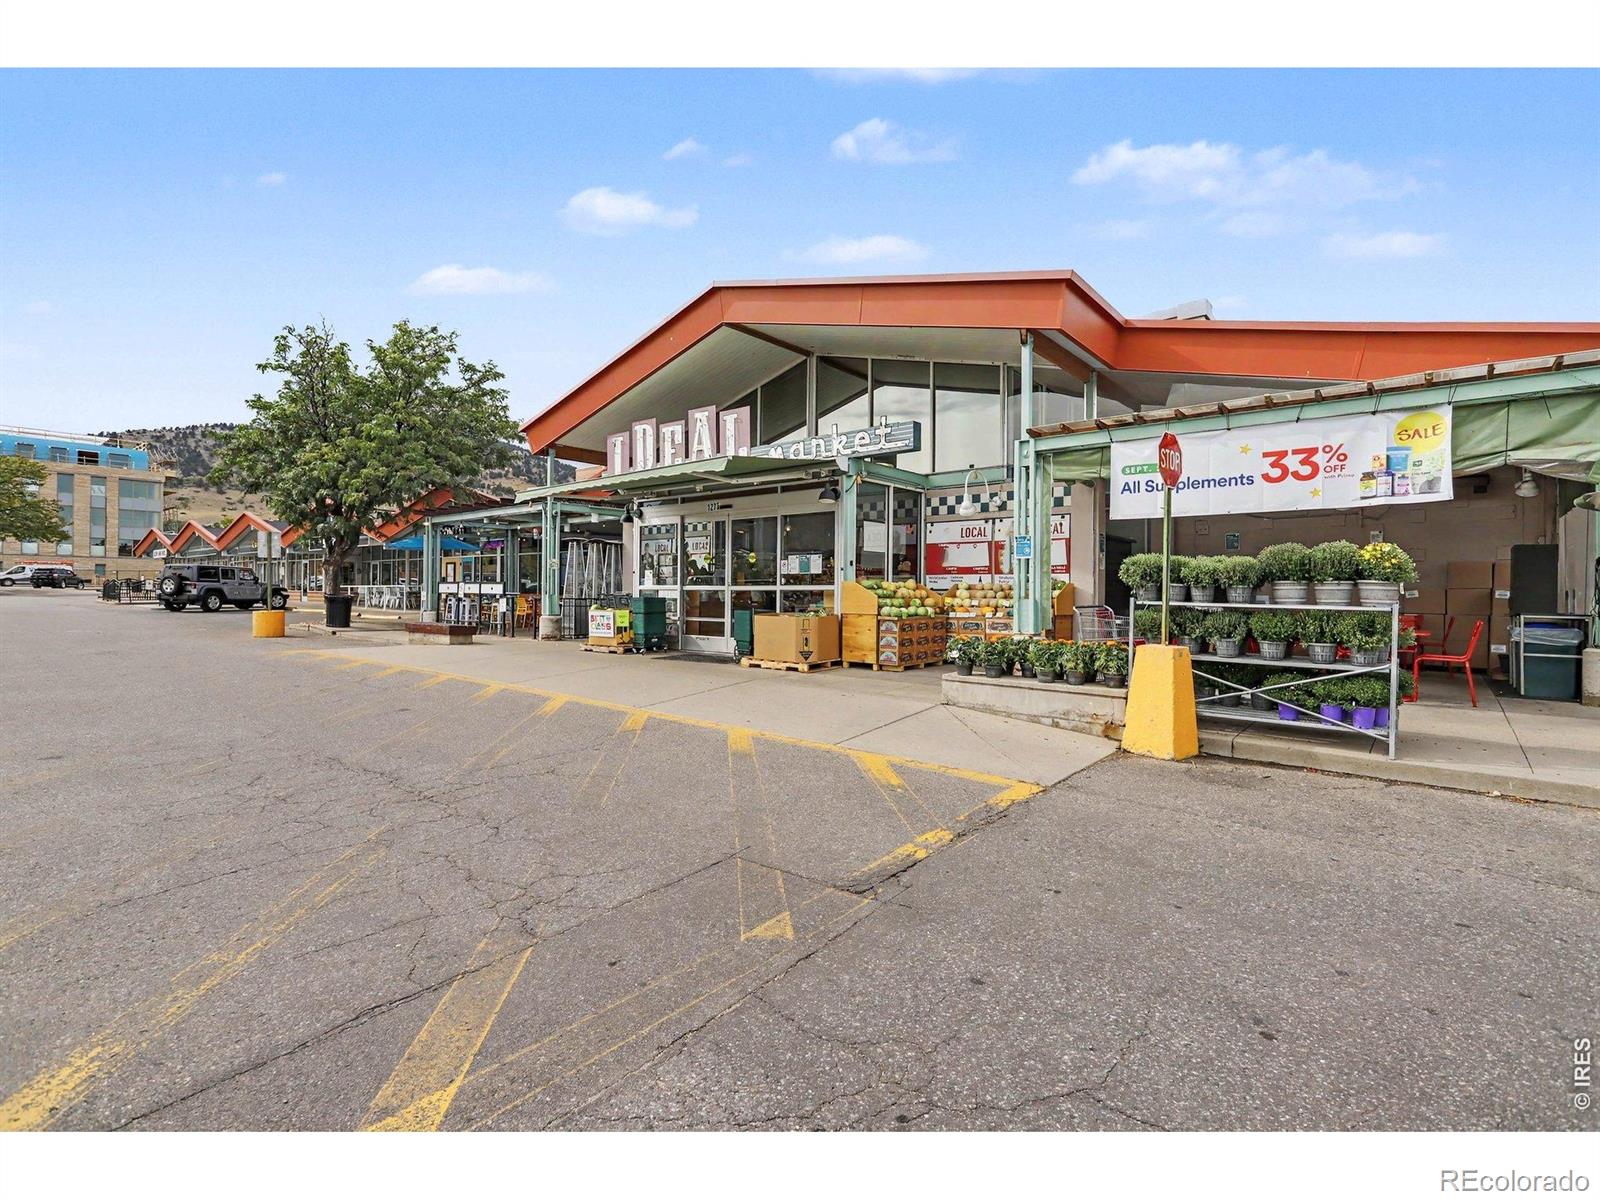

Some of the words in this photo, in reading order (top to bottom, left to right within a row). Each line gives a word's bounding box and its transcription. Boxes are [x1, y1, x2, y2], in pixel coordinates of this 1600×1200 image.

[1396, 423, 1443, 442] SALE
[611, 410, 748, 476] IDEAL
[1160, 448, 1180, 471] STOP
[1323, 463, 1347, 474] OFF
[1125, 465, 1152, 474] SEPT.
[1120, 480, 1141, 495] All
[1144, 474, 1255, 494] Suplements
[960, 526, 988, 539] LOCAL
